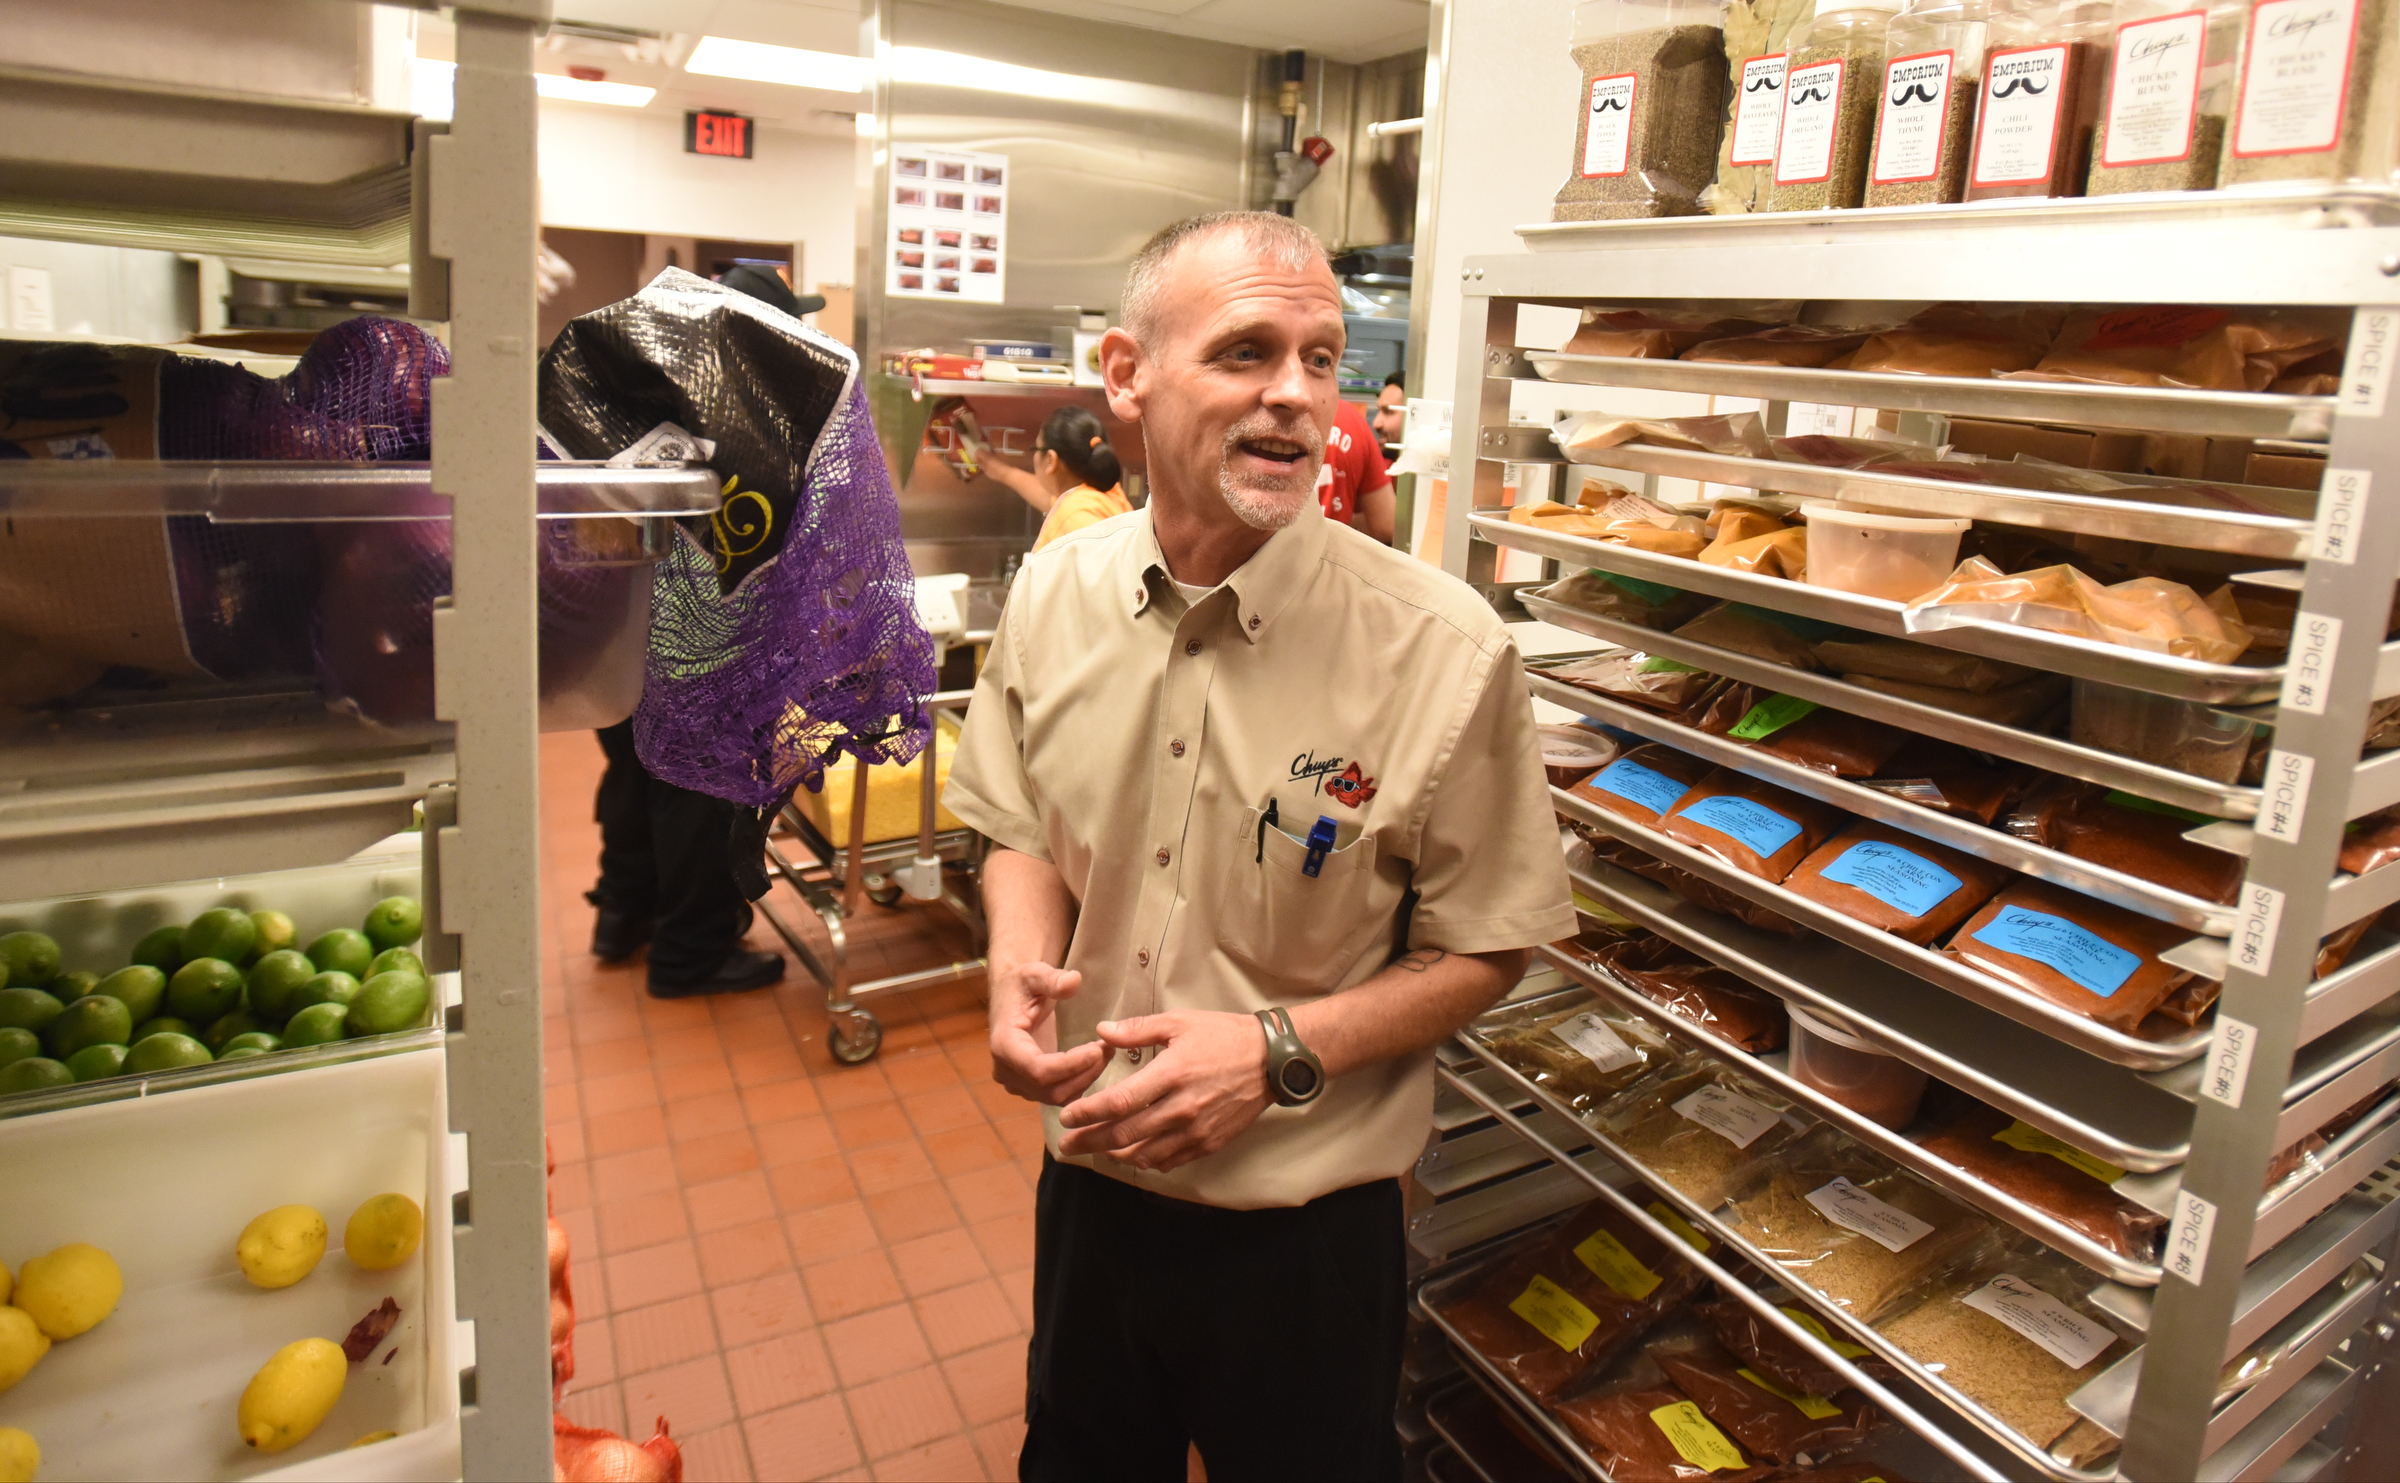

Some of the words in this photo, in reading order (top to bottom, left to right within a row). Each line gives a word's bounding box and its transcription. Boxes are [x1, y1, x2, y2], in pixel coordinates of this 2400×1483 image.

[1746, 63, 1784, 77] EMPORIUM
[1892, 63, 1944, 83] EMPORIUM
[1992, 58, 2054, 77] EMPORIUM
[1791, 72, 1834, 88] EMPORIUM
[2131, 71, 2178, 85] CHICKEN
[1592, 84, 1631, 97] EMPORIUM
[2137, 83, 2171, 95] BLEND
[1796, 115, 1819, 123] WHOLE
[1897, 114, 1925, 124] WHOLE
[2002, 114, 2028, 123] CHILI
[695, 113, 746, 157] EXIT
[1791, 124, 1823, 134] OREGANO
[1898, 125, 1925, 135] THYME
[1994, 125, 2033, 135] POWDER
[2357, 315, 2390, 377] SPICE
[2353, 384, 2372, 405] #1
[2300, 620, 2329, 680] SPICE
[2295, 684, 2314, 706] #3
[1886, 864, 1928, 889] SEASONING
[1900, 865, 1925, 880] CARNE
[1902, 860, 1925, 877] CHILE
[1925, 871, 1943, 884] CON
[2053, 935, 2106, 966] SEASONING
[2068, 935, 2101, 954] CARNE
[2068, 931, 2098, 949] CHILE
[2099, 946, 2121, 961] CON
[2179, 1199, 2205, 1253] SPICE
[2175, 1252, 2192, 1275] #8
[2042, 1309, 2089, 1342] SEASONING
[2063, 1316, 2084, 1331] RICE
